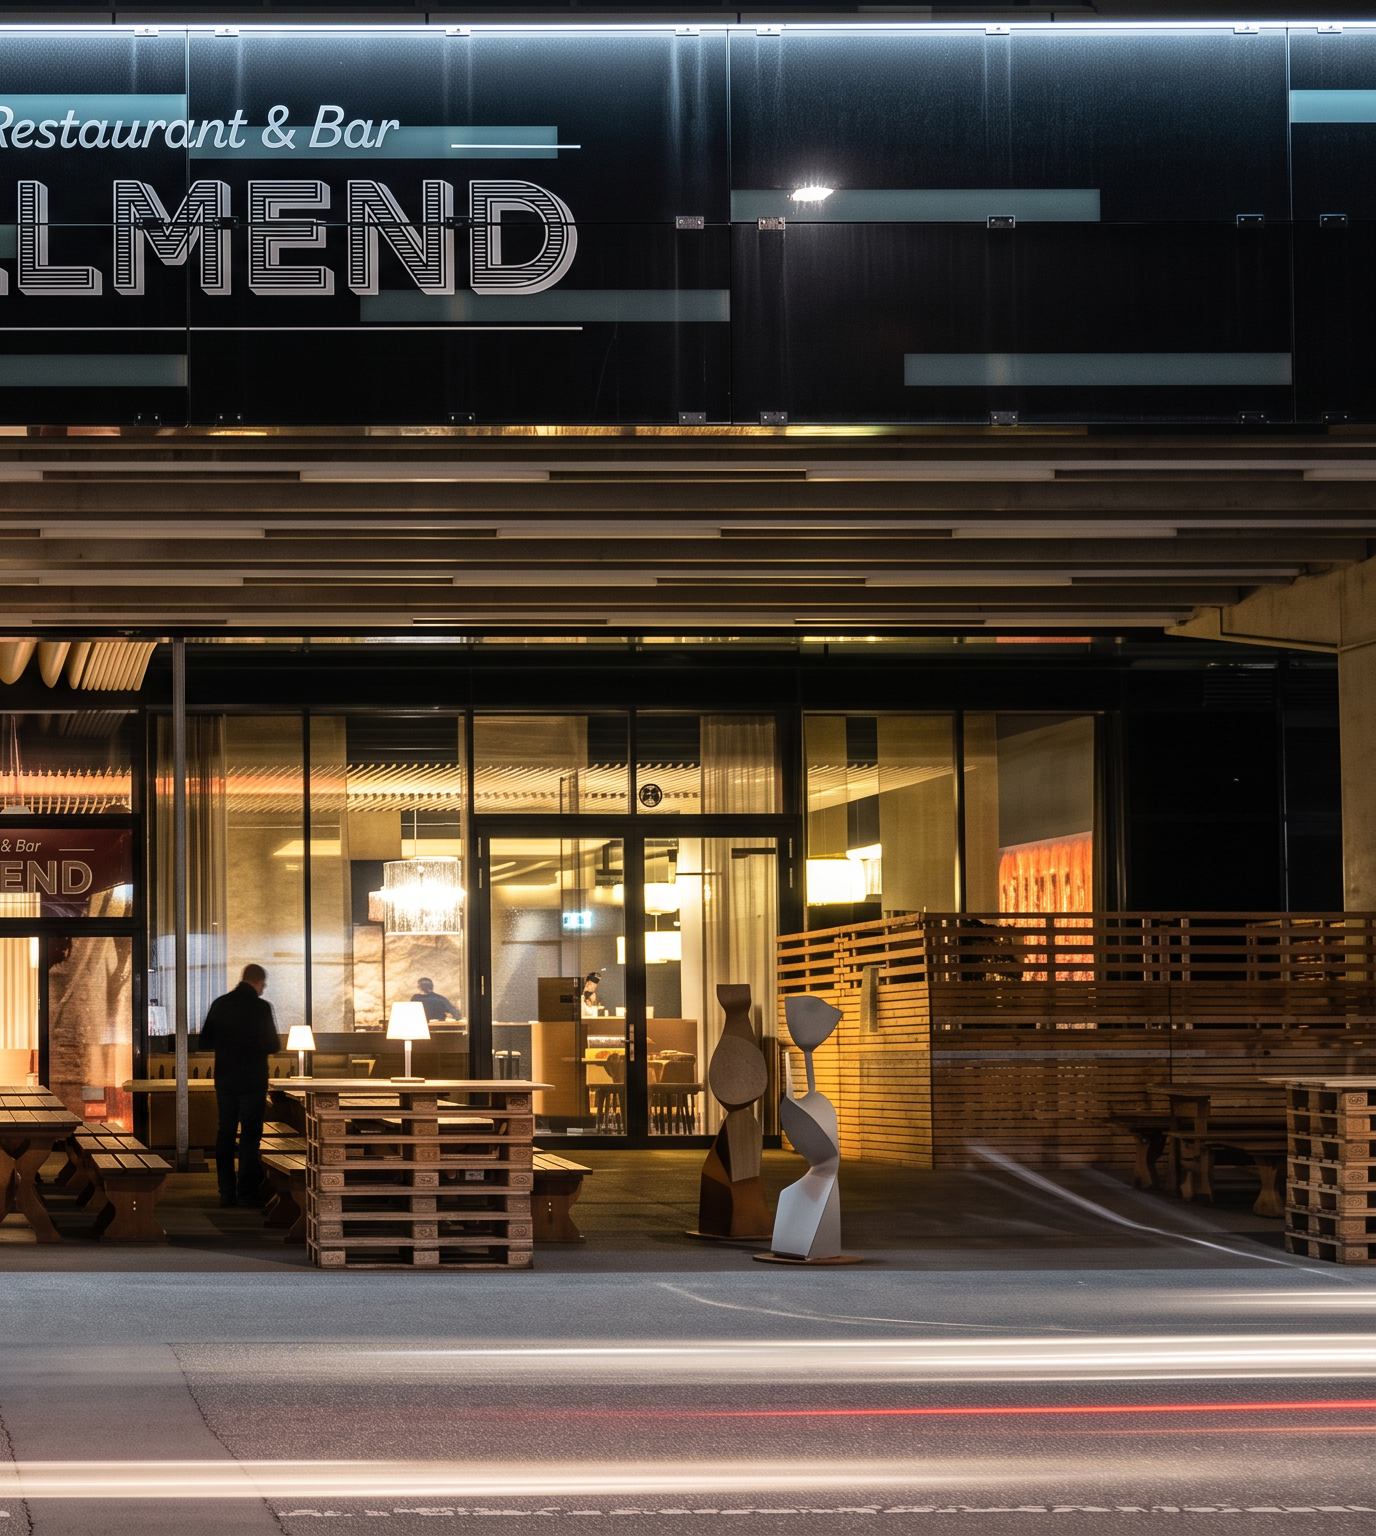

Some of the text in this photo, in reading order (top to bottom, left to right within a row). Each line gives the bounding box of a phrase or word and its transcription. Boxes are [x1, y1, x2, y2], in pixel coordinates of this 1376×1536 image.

[261, 104, 296, 150] &
[308, 104, 400, 149] Bar
[0, 838, 12, 853] &
[15, 839, 42, 853] Bar
